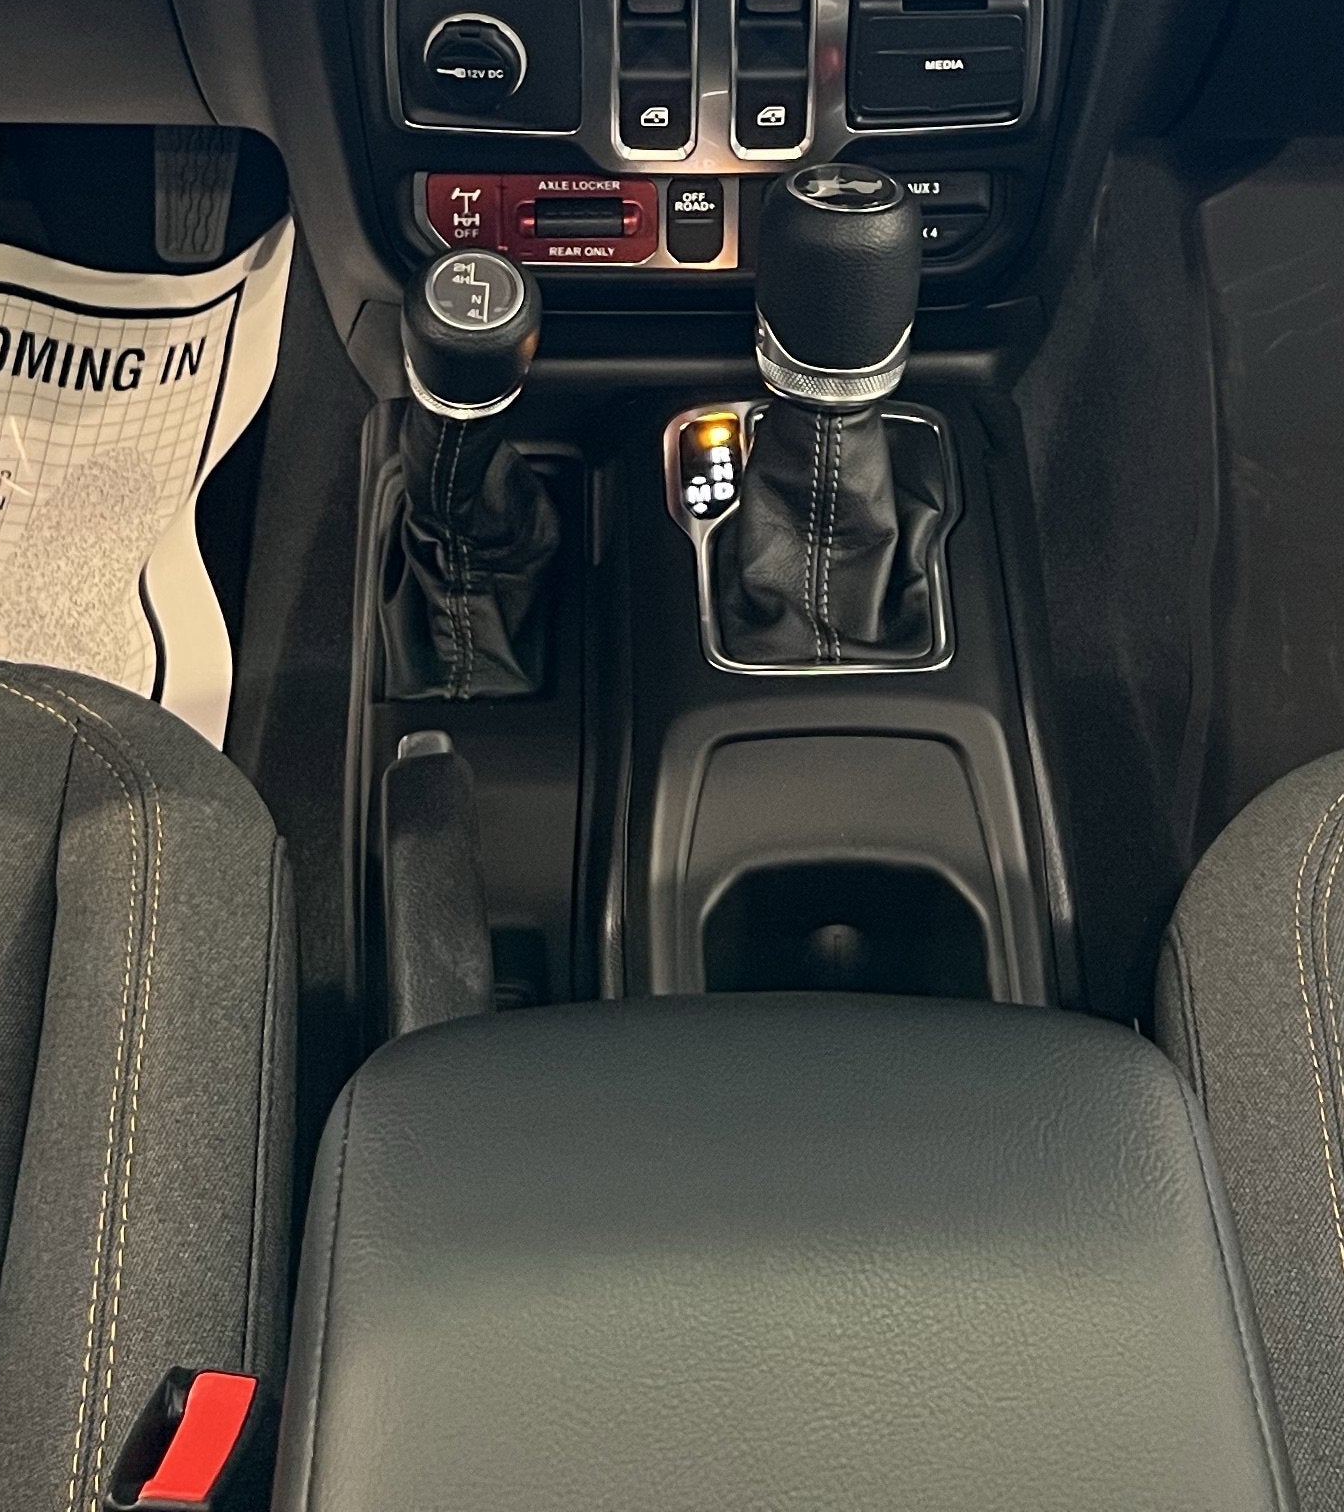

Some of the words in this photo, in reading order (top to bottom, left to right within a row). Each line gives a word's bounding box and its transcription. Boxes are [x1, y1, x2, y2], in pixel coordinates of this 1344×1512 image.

[924, 59, 964, 70] MEDIA
[466, 69, 486, 80] 12V
[487, 69, 504, 80] DC
[538, 181, 570, 191] AXLE
[572, 180, 621, 191] LOCKER
[931, 182, 940, 194] 3
[682, 192, 706, 203] OFF
[674, 201, 717, 212] ROAD+
[454, 228, 479, 238] OFF
[929, 227, 938, 238] 4
[548, 246, 582, 257] REAR
[584, 246, 616, 258] ONLY
[451, 274, 470, 284] 4H
[471, 294, 482, 305] N
[467, 308, 484, 319] 4L
[159, 335, 207, 385] IN
